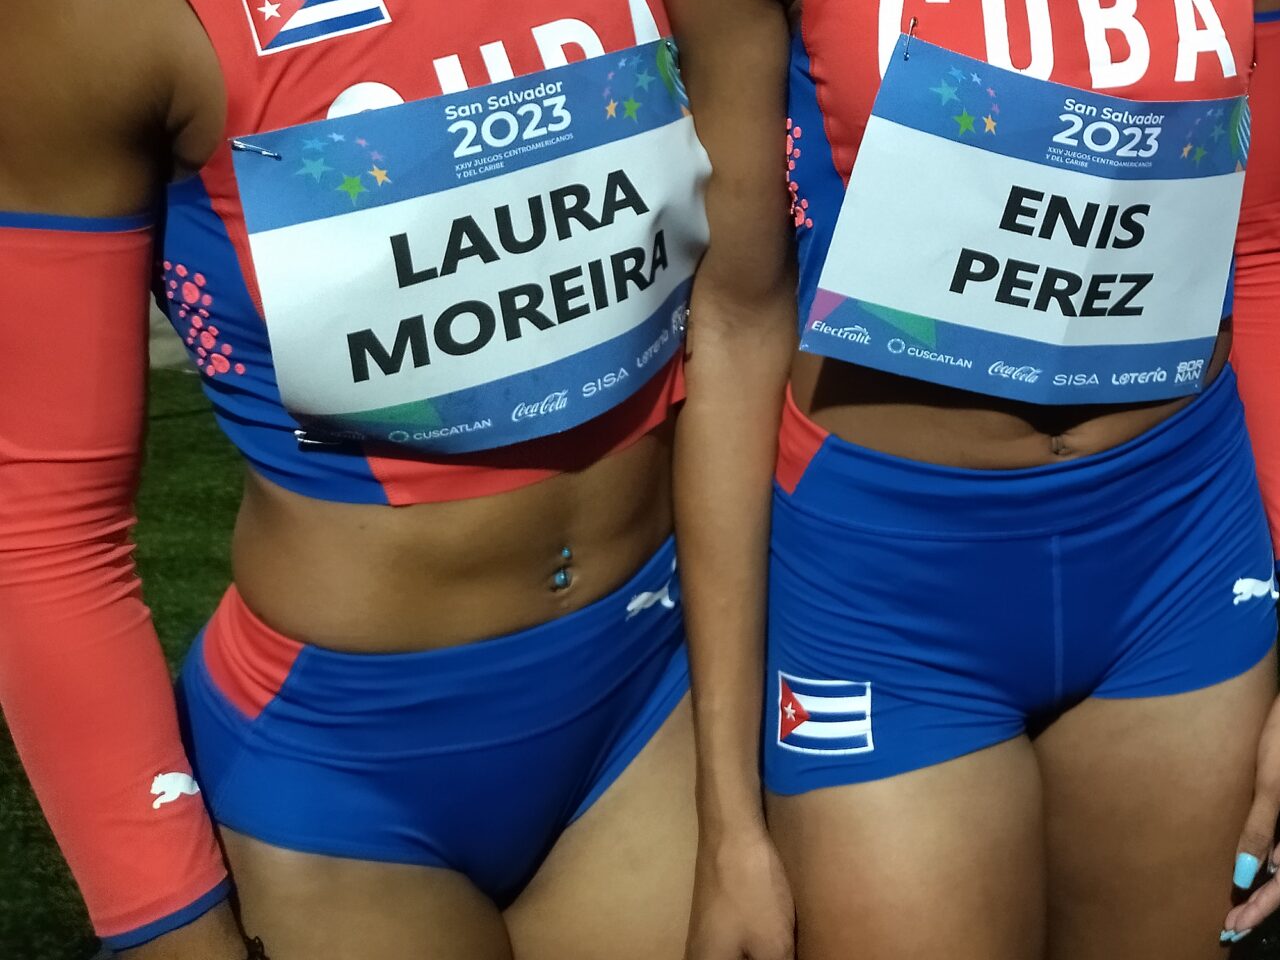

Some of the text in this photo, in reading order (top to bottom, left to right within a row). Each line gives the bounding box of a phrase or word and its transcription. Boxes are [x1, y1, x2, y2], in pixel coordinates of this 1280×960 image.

[445, 81, 563, 121] San Salvador
[1063, 98, 1165, 125] San Salvador
[447, 94, 572, 159] 2023
[1052, 113, 1162, 158] 2023
[464, 169, 477, 178] DEL
[479, 162, 505, 173] CARIBE
[474, 154, 503, 166] JUEGOS
[504, 133, 573, 158] CENTROAMERICANOS
[1051, 154, 1064, 163] DEL
[1065, 157, 1088, 168] CARIBE
[1064, 149, 1091, 161] JUEGOS
[390, 169, 650, 288] LAURA
[999, 185, 1151, 250] ENIS
[948, 247, 1155, 318] PEREZ
[346, 229, 668, 383] MOREIRA
[811, 320, 871, 345] Electrolit
[907, 347, 973, 369] CUSCATLAN
[1052, 373, 1100, 386] SISA
[1177, 359, 1204, 373] BOR
[1174, 371, 1202, 384] NAN
[413, 419, 491, 440] CUSCATLAN
[582, 368, 629, 398] SISA
